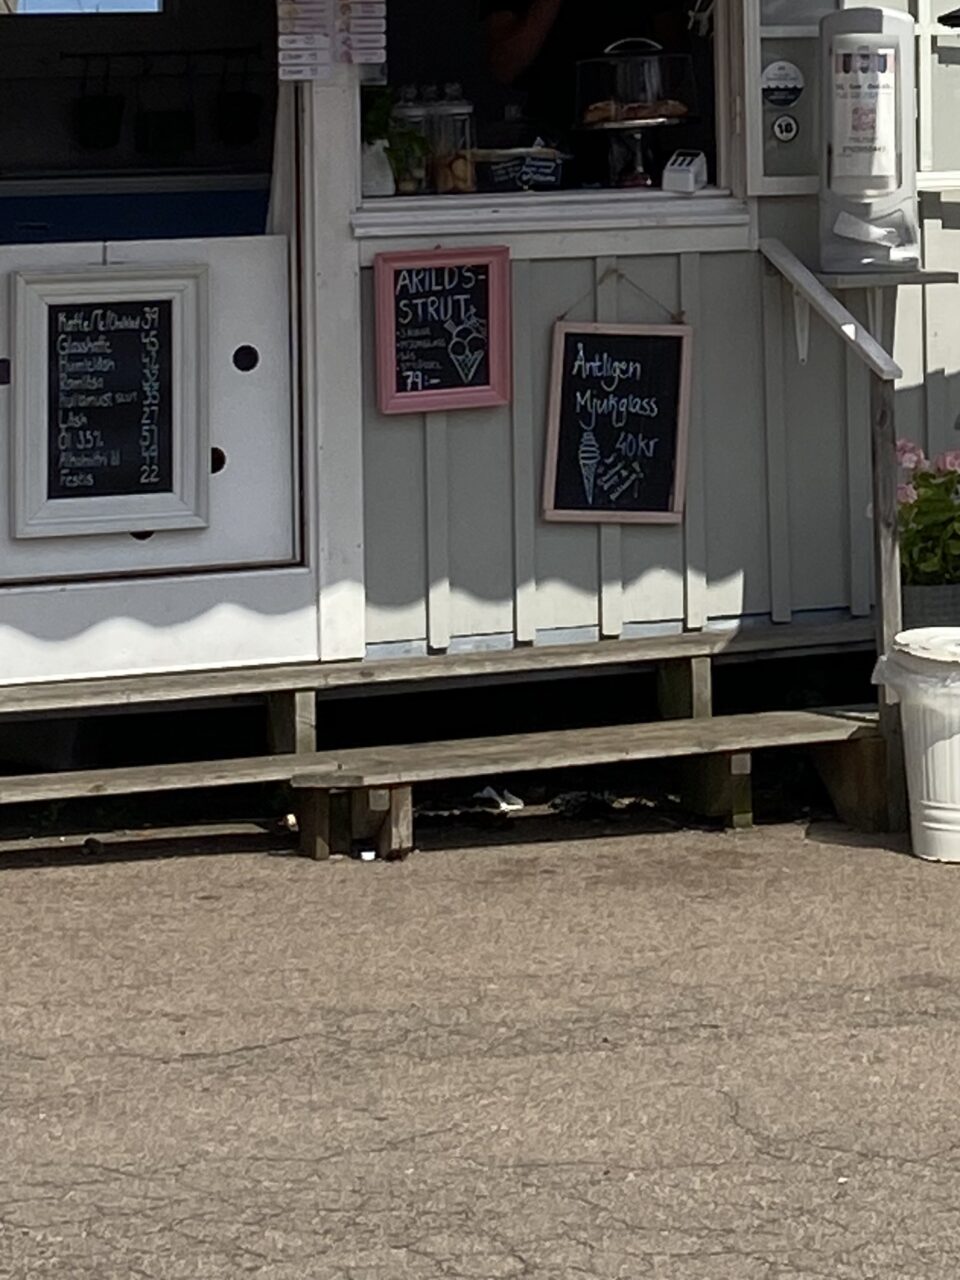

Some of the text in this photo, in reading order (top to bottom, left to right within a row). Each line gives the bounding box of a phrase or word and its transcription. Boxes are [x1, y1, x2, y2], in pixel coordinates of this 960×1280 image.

[141, 307, 159, 329] 39
[399, 295, 471, 324] STRUT
[141, 331, 159, 350] 45
[141, 406, 159, 423] 27
[575, 389, 658, 430] Mjukglass
[140, 465, 160, 483] 22
